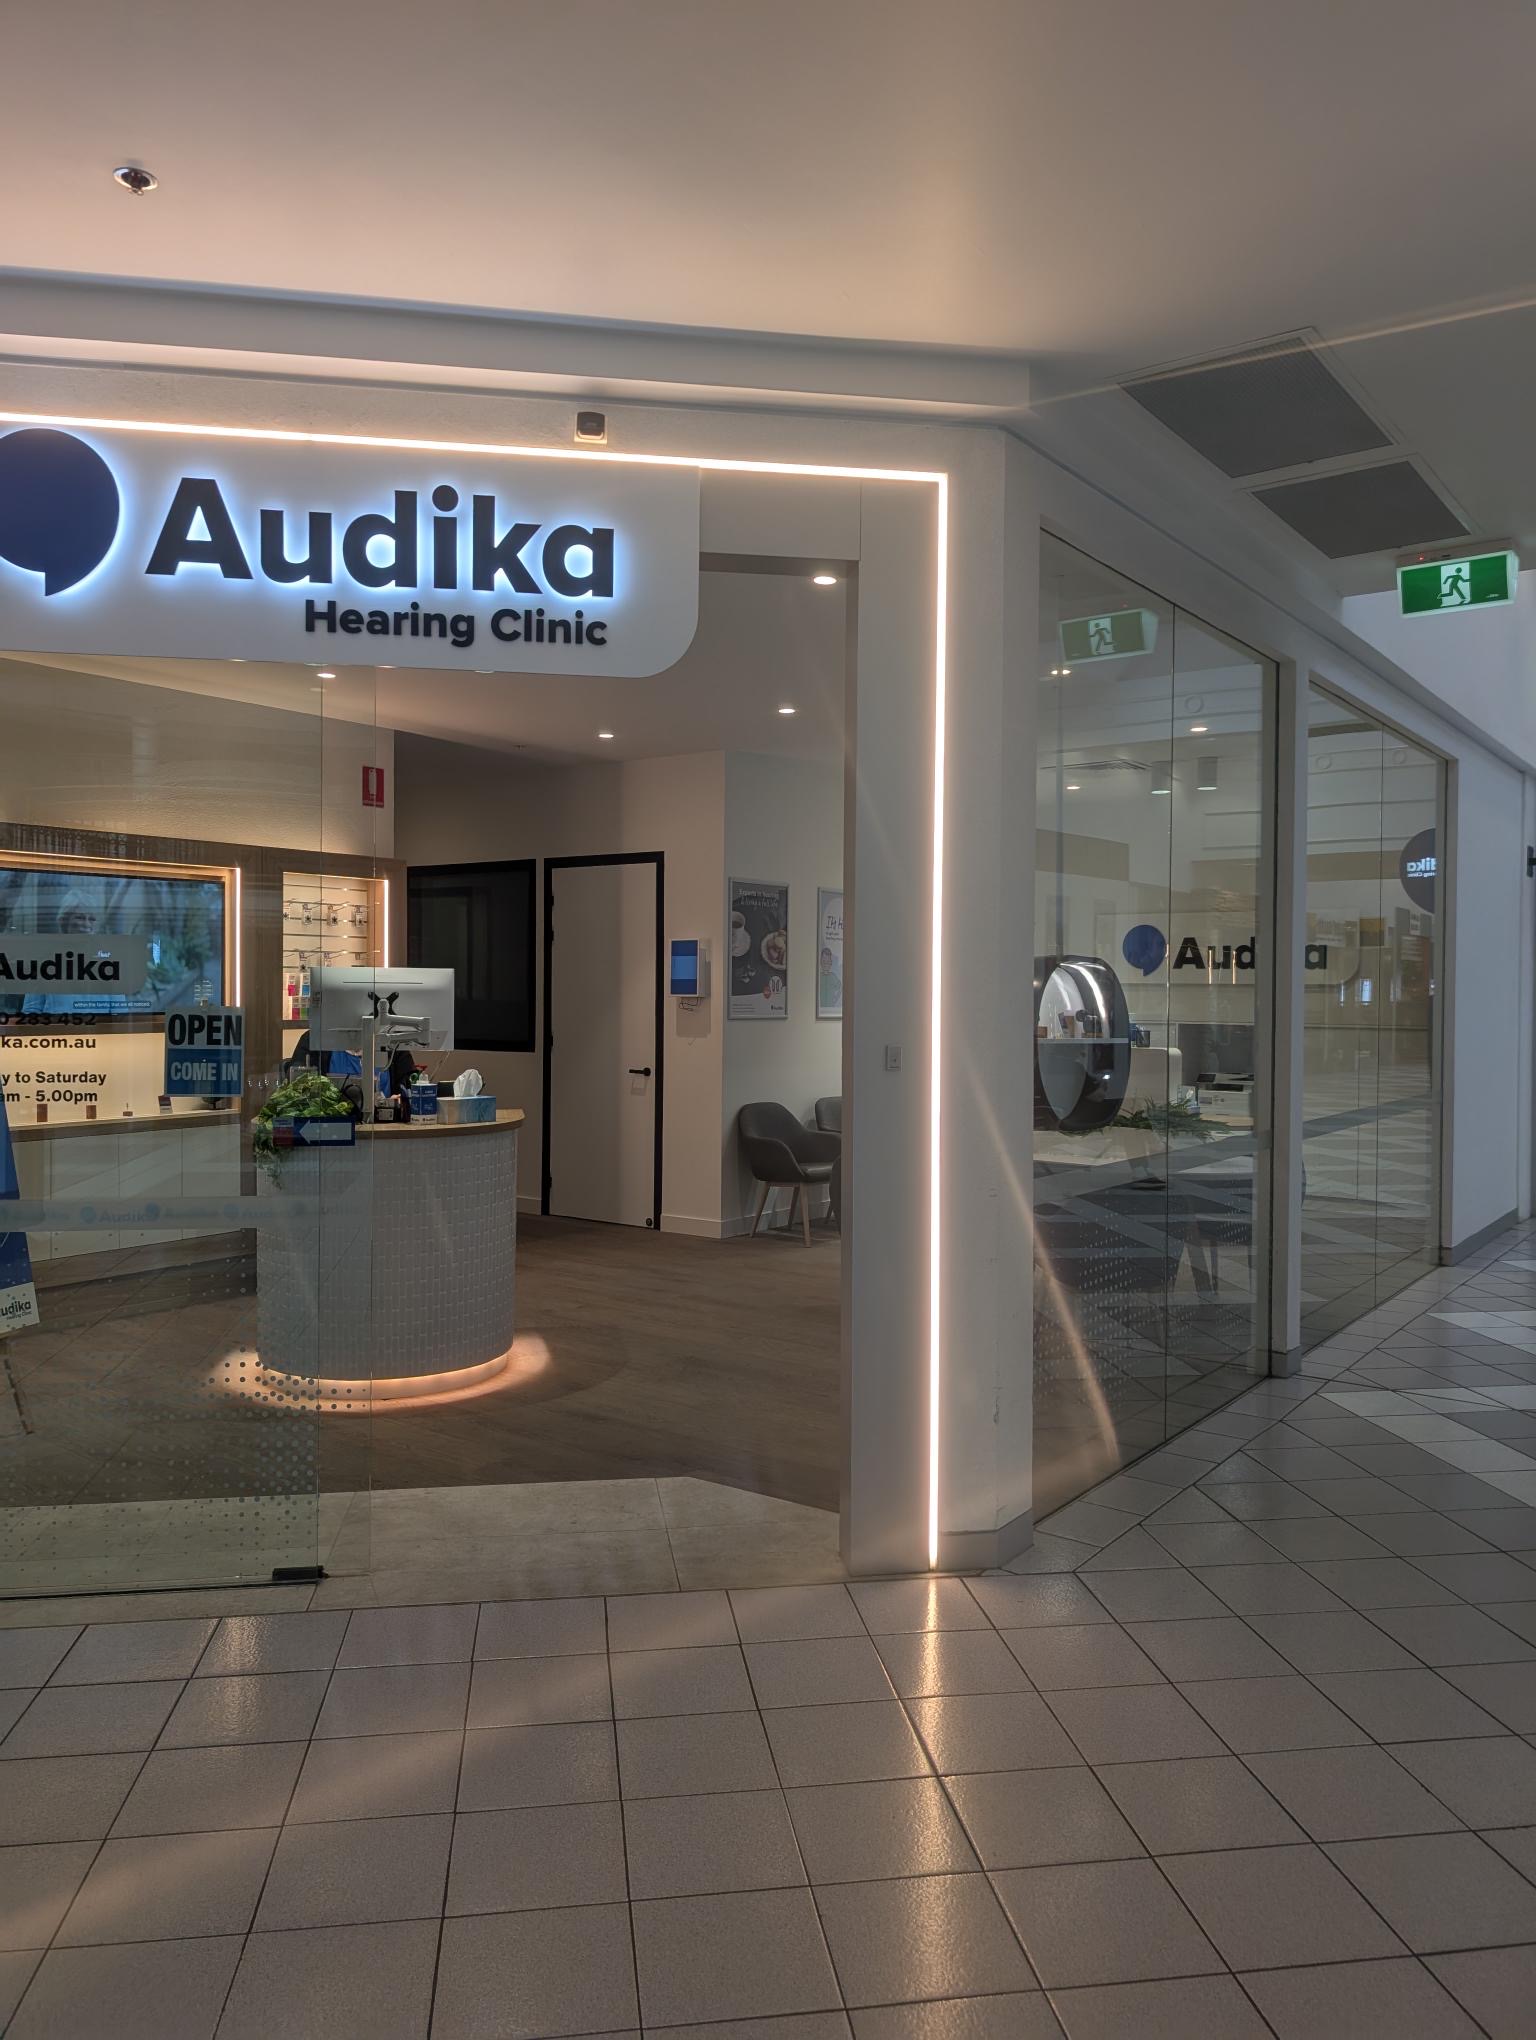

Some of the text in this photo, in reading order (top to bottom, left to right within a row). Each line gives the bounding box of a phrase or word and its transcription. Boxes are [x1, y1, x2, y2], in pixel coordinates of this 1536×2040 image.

[145, 477, 615, 598] Audika
[305, 599, 608, 648] Hearing Clinic
[1173, 936, 1327, 970] Auda
[58, 1012, 96, 1025] 452
[168, 1014, 242, 1046] OPEN
[15, 1072, 31, 1083] to
[35, 1071, 107, 1086] Saturday
[170, 1062, 239, 1081] COME IN
[35, 1090, 98, 1105] 5.00pm
[0, 1300, 31, 1316] udika
